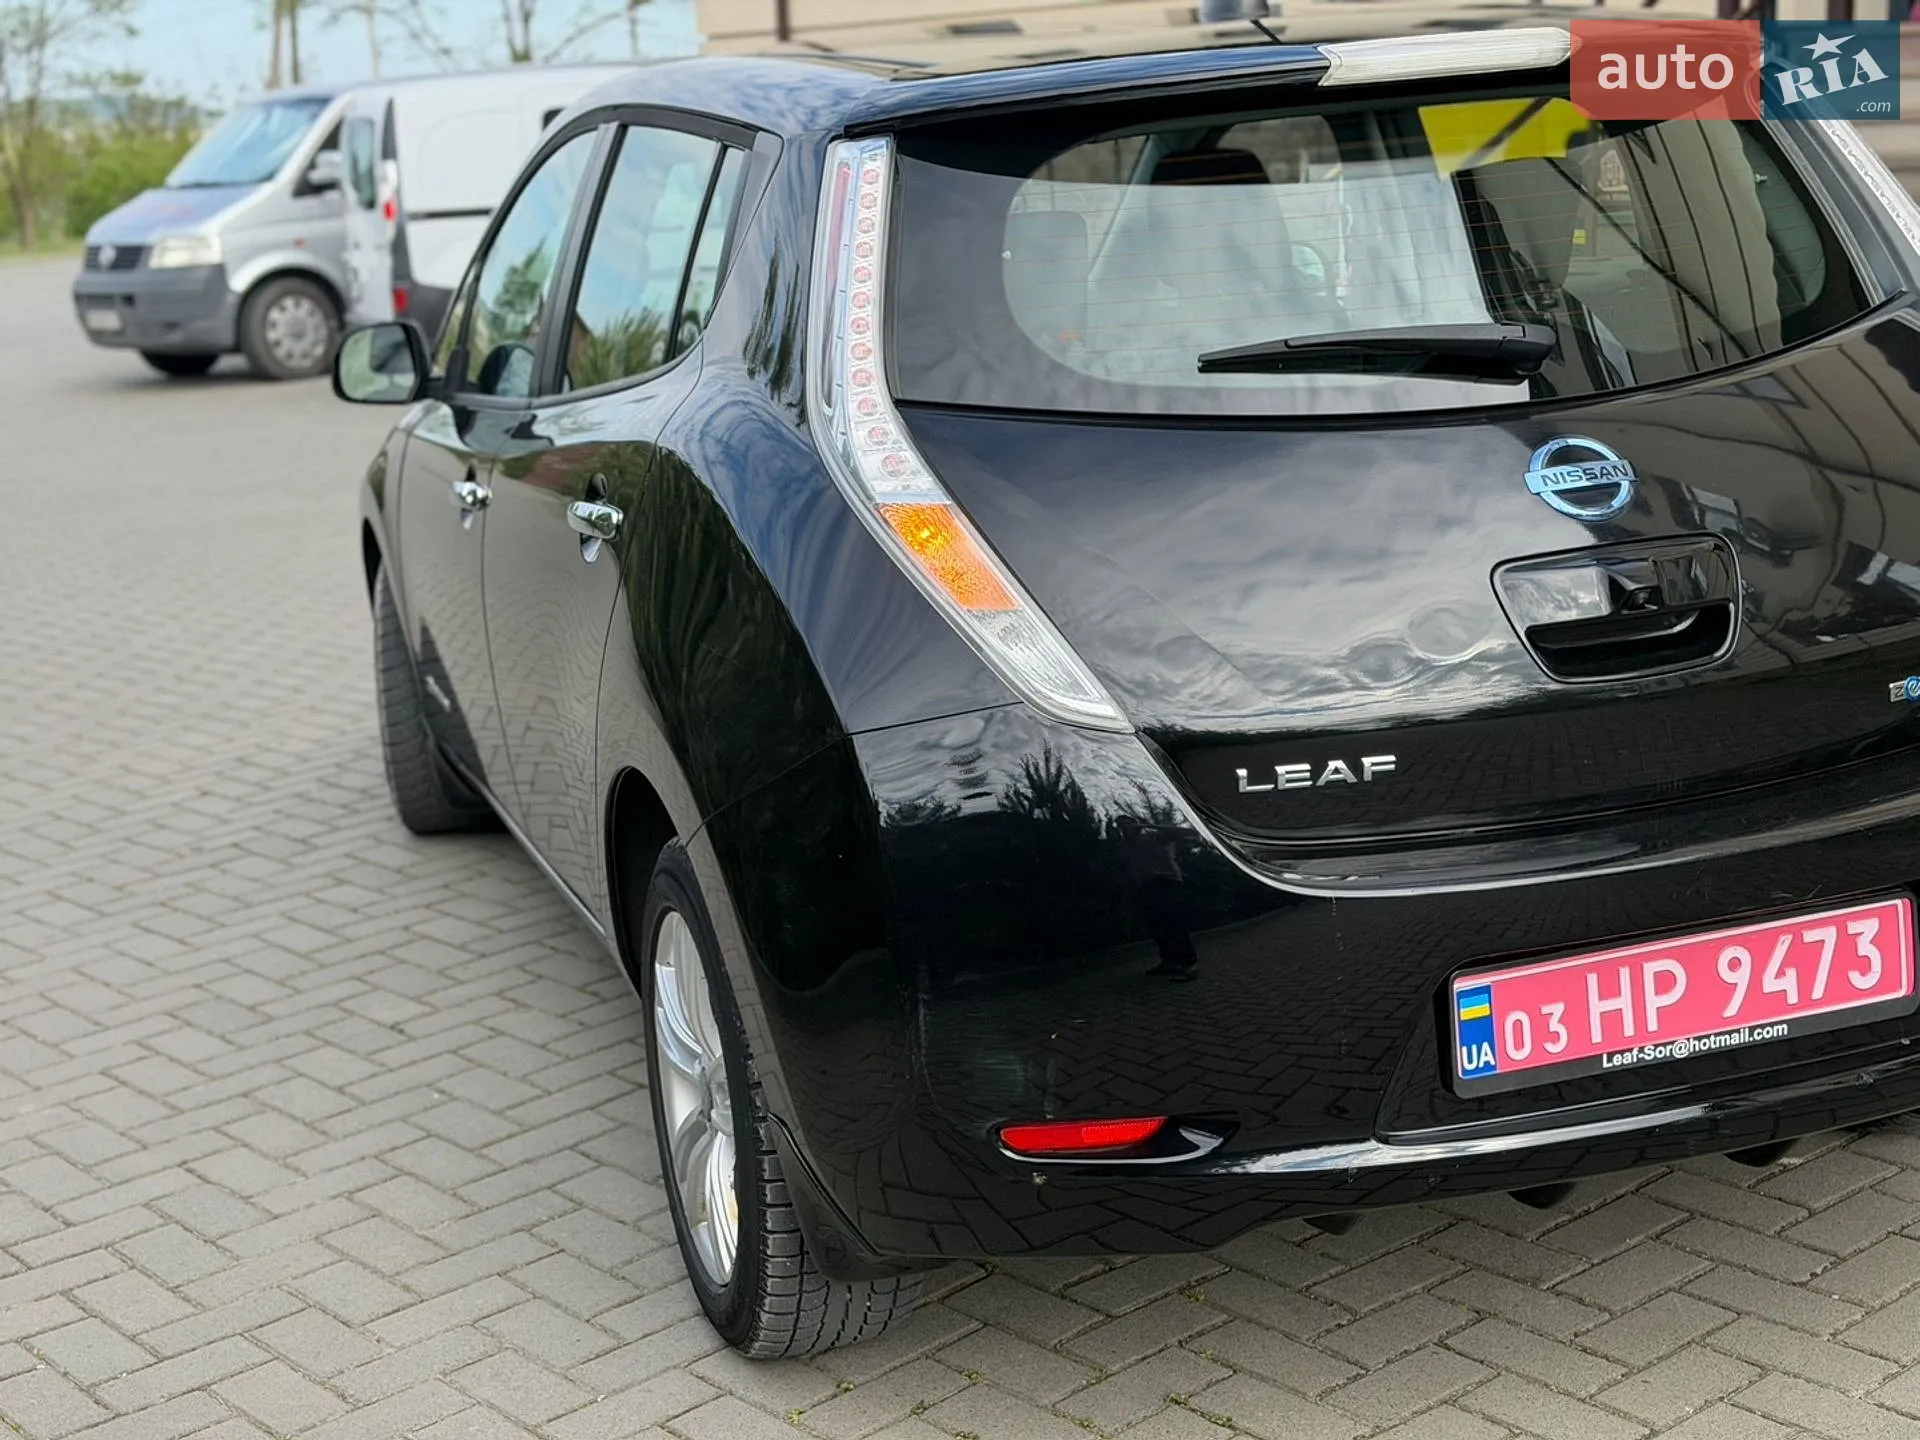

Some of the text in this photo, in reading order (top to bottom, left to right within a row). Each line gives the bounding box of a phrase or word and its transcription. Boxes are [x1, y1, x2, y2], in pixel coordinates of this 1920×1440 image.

[1540, 464, 1629, 487] NISSAN
[1235, 754, 1397, 793] LEAF
[1503, 917, 1882, 1061] 03 HP 9473
[1461, 1042, 1495, 1071] UA
[1602, 1023, 1788, 1069] Leaf-Sor@hotmail.com
